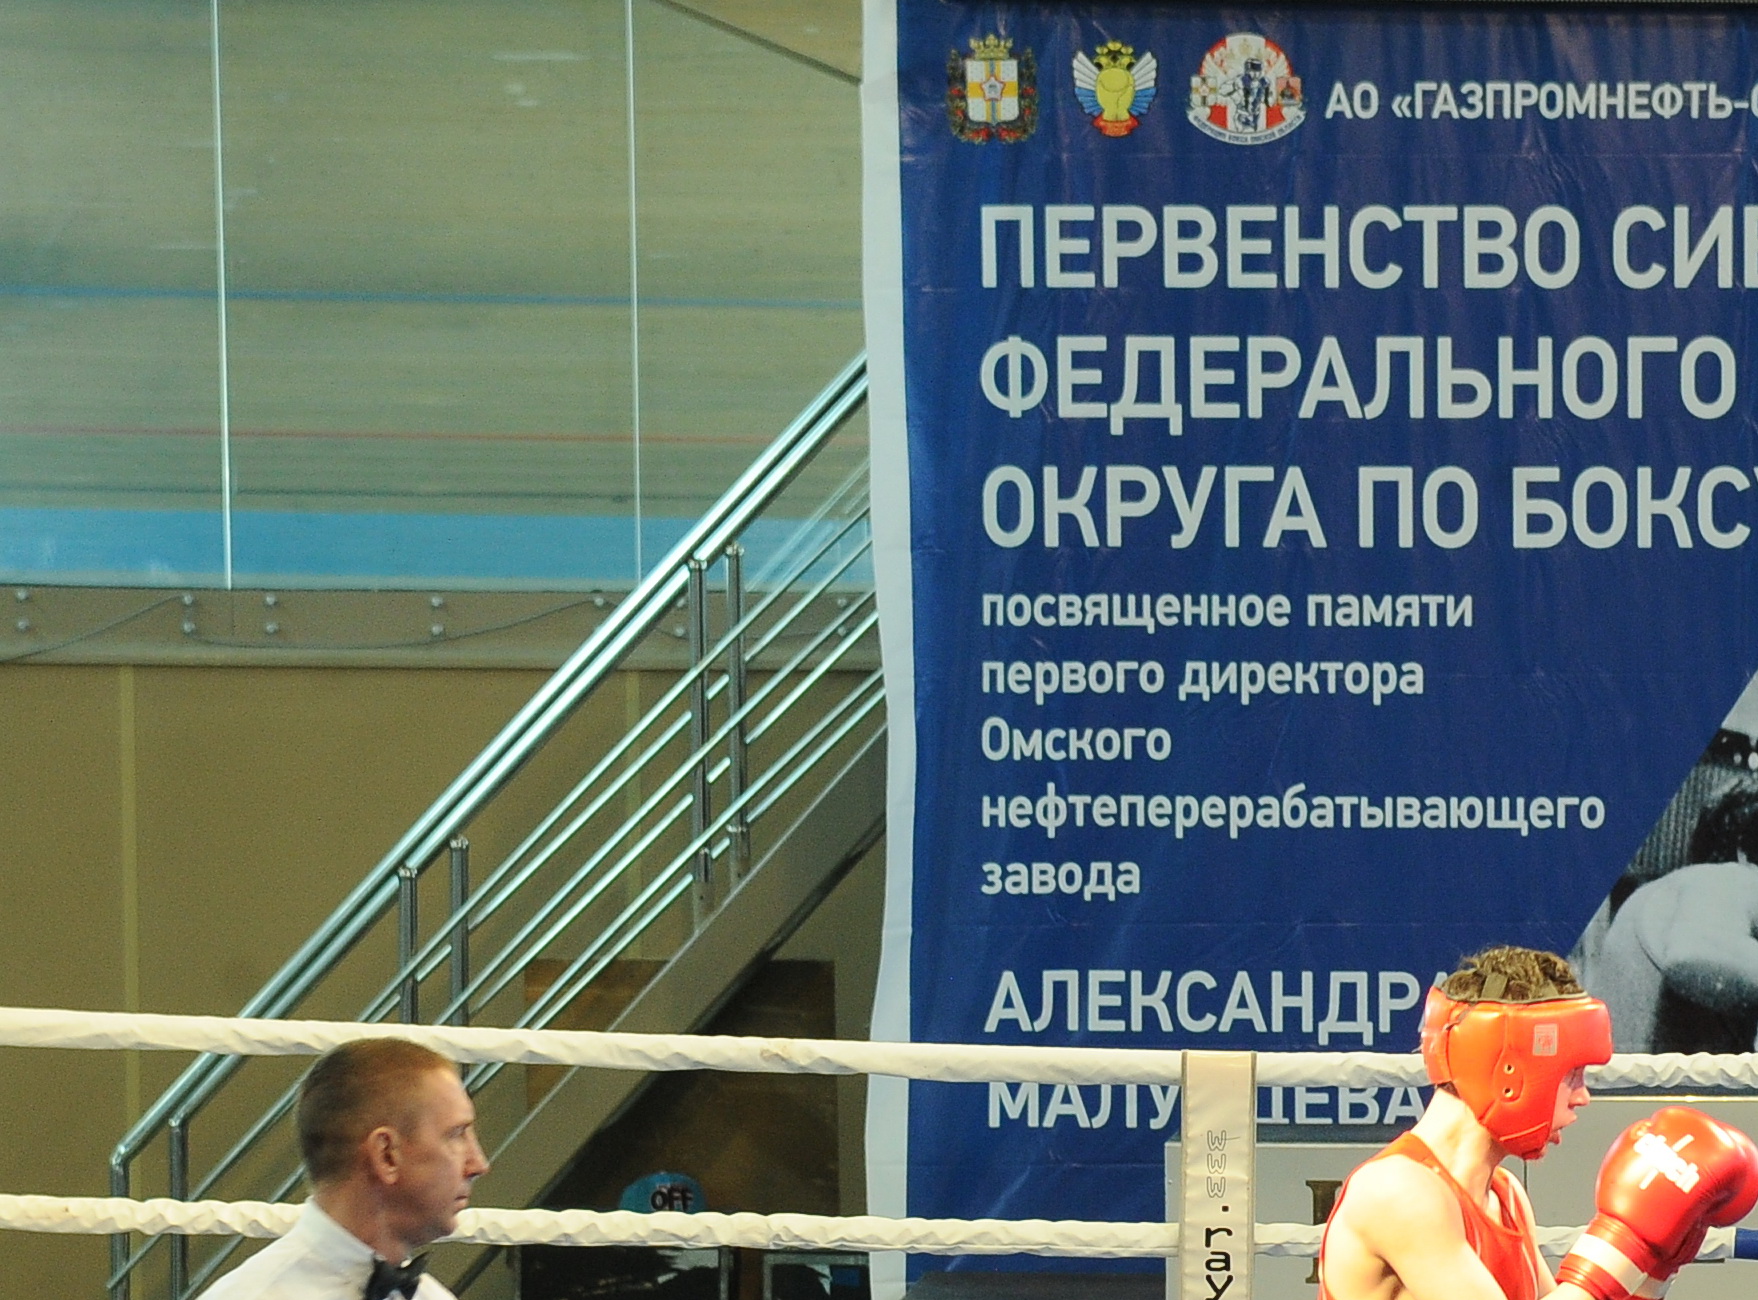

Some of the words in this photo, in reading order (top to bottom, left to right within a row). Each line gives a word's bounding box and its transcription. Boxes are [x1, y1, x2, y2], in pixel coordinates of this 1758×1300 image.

[1325, 82, 1379, 119] АО
[980, 204, 1581, 290] ПЕРВЕНСТВО
[980, 334, 1737, 437] ФЕДЕРАЛЬНОГО
[982, 464, 1328, 550] ОКРУГА
[1358, 465, 1480, 550] ПО
[981, 593, 1292, 635] посвященное
[1306, 593, 1474, 628] памяти
[981, 660, 1166, 706] первого
[1178, 660, 1425, 707] директора
[981, 716, 1173, 762] Омского
[981, 782, 1606, 840] нефтеперерабатывающего
[980, 861, 1141, 902] завода
[983, 968, 1448, 1047] АЛЕКСАНДР
[987, 1084, 1427, 1129] МАЛУЕВА
